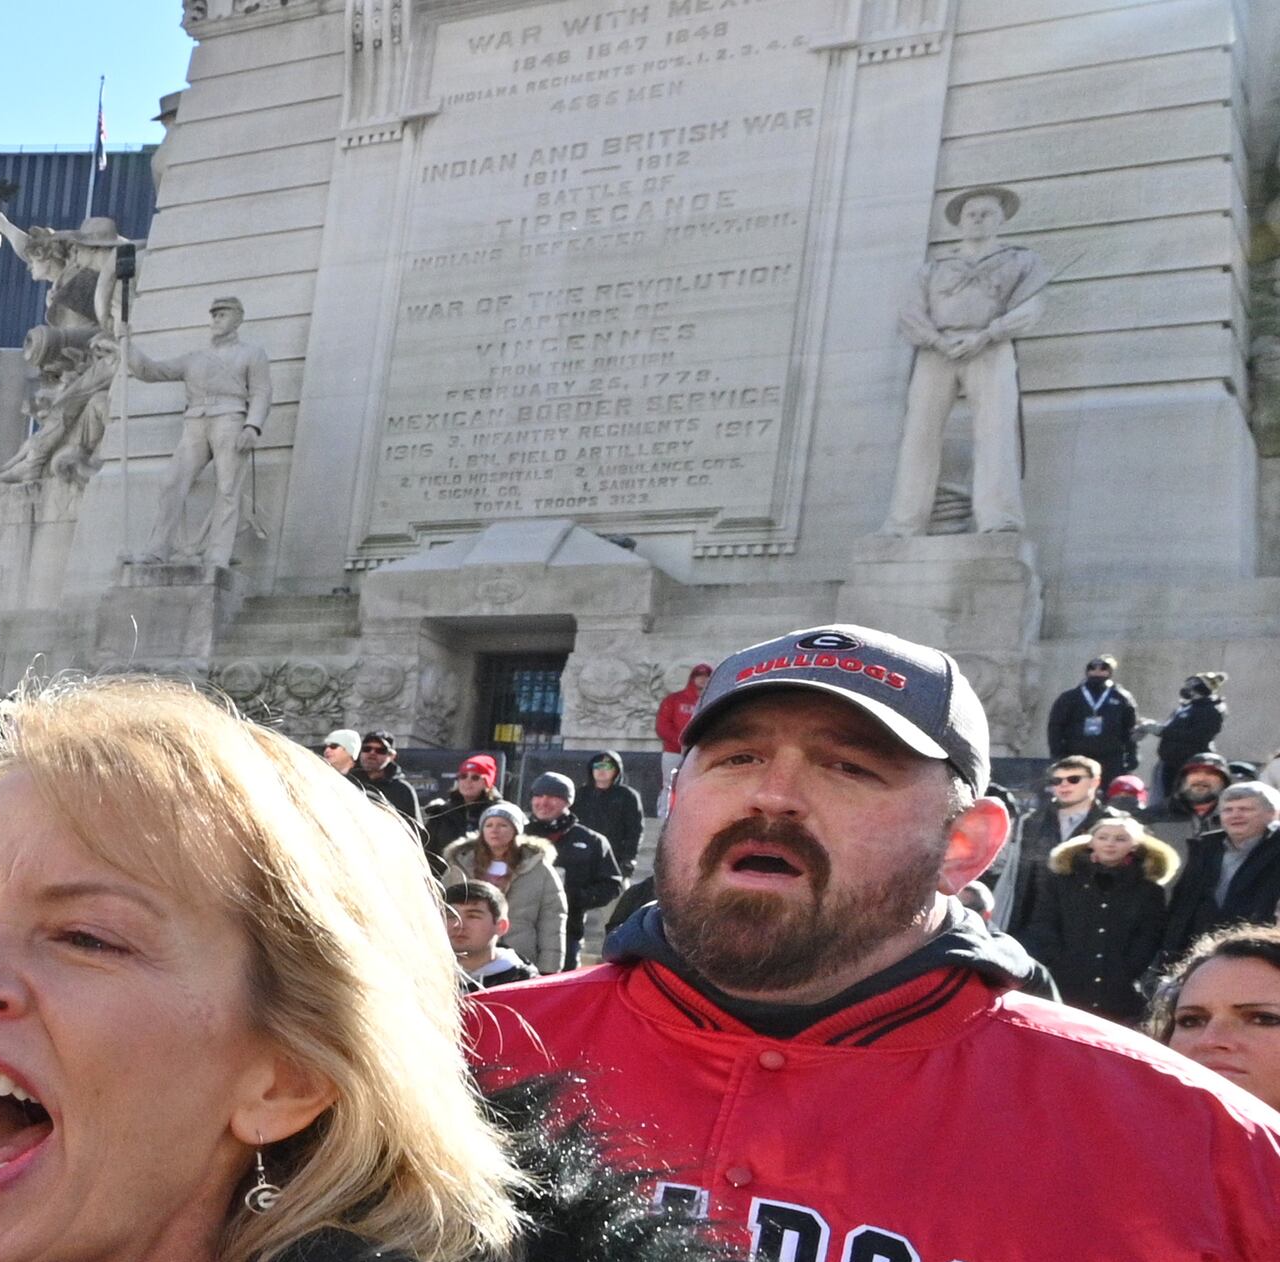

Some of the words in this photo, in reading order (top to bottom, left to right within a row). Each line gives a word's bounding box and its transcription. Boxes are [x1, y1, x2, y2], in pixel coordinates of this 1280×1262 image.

[468, 25, 542, 54] WAR
[562, 5, 648, 37] WITH
[587, 36, 648, 60] 1847
[665, 22, 728, 46] 1848
[447, 85, 517, 105] INDIANA
[526, 63, 636, 93] REGIMENTS
[626, 80, 683, 102] MEN
[422, 153, 517, 184] INDIAN
[528, 141, 588, 168] AND
[601, 120, 729, 157] BRITISH
[742, 107, 814, 136] WAR
[523, 168, 567, 188] 1811
[636, 150, 690, 172] 1812
[536, 180, 632, 207] BATTLE
[642, 174, 675, 193] OF
[412, 248, 502, 272] INDIANS
[407, 300, 464, 321] WAR
[476, 294, 513, 315] OF
[528, 286, 584, 309] THE
[596, 263, 792, 303] REVOLUTION
[504, 306, 619, 331] CAPTURE
[476, 323, 696, 357] VINCENNES
[489, 362, 541, 379] FROM
[549, 359, 586, 376] THE
[446, 380, 576, 401] FEBRUARY
[387, 408, 504, 433] MEXICAN
[518, 397, 633, 423] BORDER
[646, 386, 781, 412] SERVICE
[472, 427, 569, 446] INFANTRY
[578, 418, 700, 440] REGIMENTS
[715, 418, 773, 440] 1917
[385, 443, 434, 461] 1916
[508, 448, 567, 465] FIELD
[576, 440, 694, 460] ARTILLERY
[420, 474, 462, 487] FIELD
[469, 468, 553, 484] HOSPITALS
[597, 460, 695, 477] AMBULANCE
[598, 476, 680, 492] SANITARY
[474, 500, 522, 512] TOTAL
[534, 496, 598, 510] TROOPS
[735, 652, 907, 692] BULLDOGS
